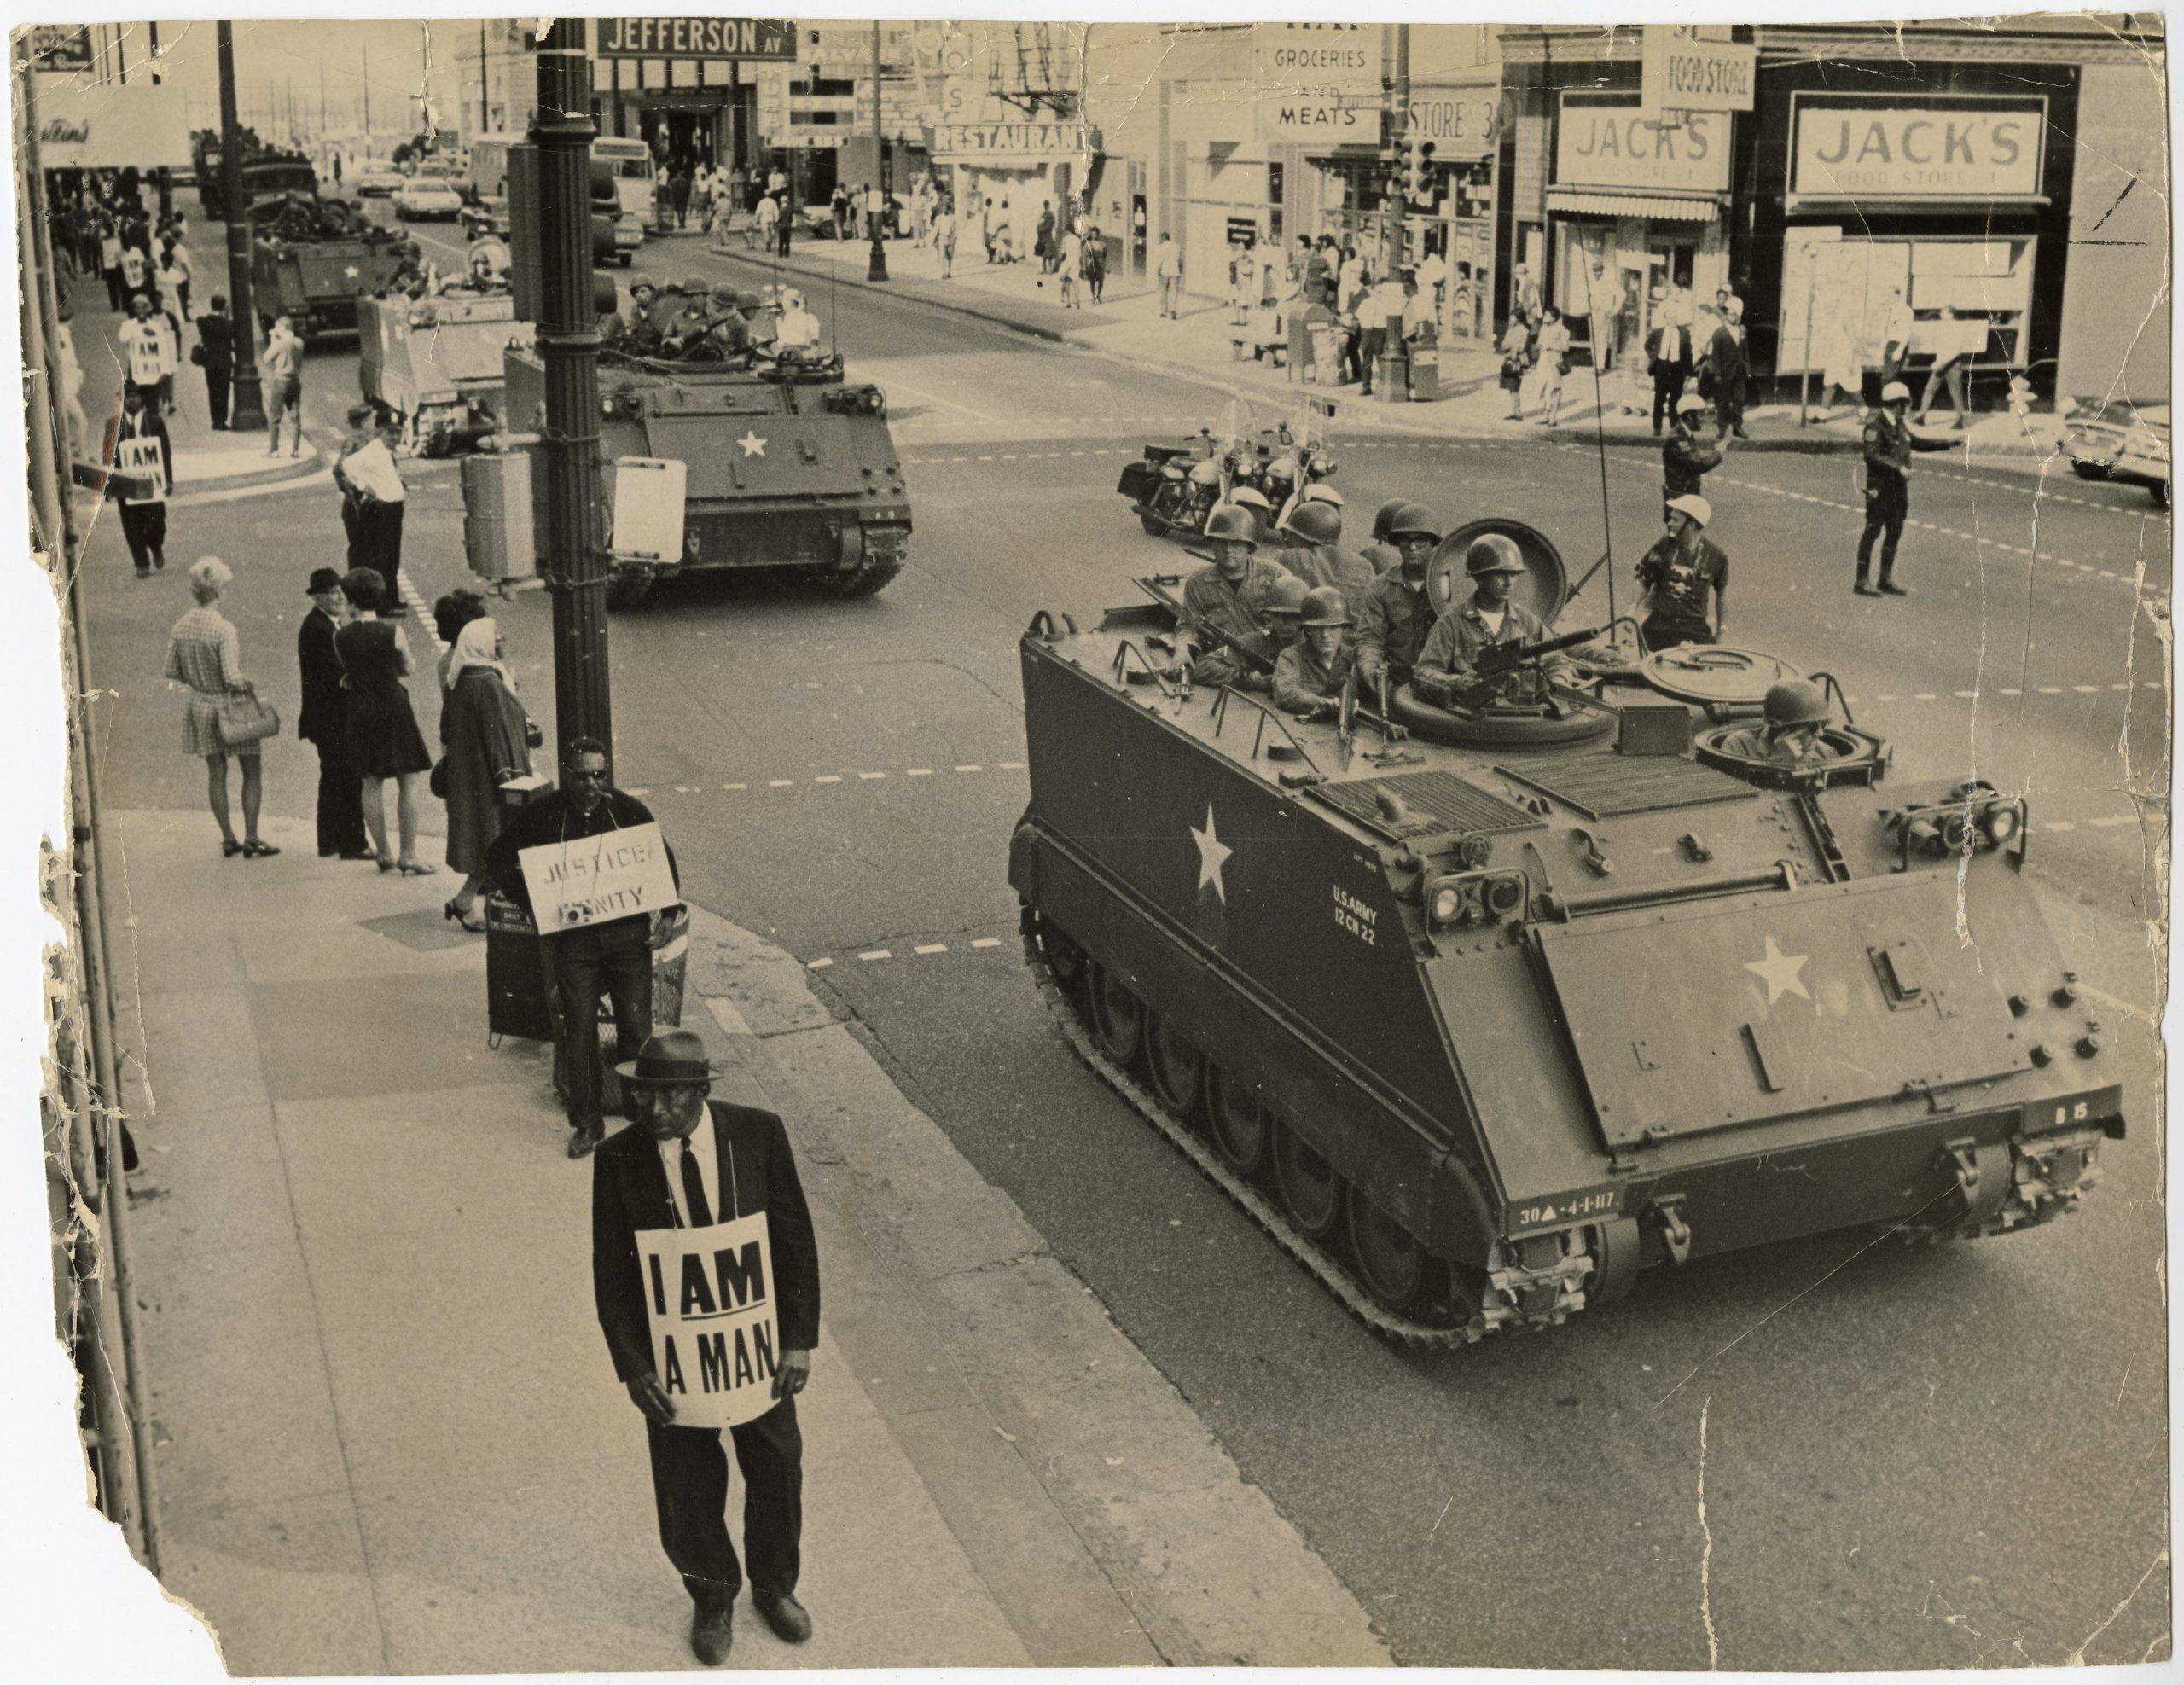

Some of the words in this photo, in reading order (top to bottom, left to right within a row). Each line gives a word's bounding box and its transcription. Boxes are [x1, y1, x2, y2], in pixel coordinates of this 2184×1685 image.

[607, 18, 757, 53] JEFFERSON
[764, 37, 781, 53] AV
[1275, 49, 1365, 67] GROCERIES
[1669, 55, 1704, 93] FOOD
[1706, 58, 1749, 95] STORE
[1298, 86, 1340, 99] AND
[1278, 107, 1356, 125] MEATS
[1409, 102, 1466, 138] STORE
[1482, 102, 1494, 139] 3
[1577, 117, 1709, 161] JACKS
[1815, 117, 2022, 165] JACK'S
[1834, 171, 1889, 185] FOOD
[1902, 171, 1964, 185] STORE
[139, 341, 160, 357] AM
[133, 445, 159, 468] AM
[544, 843, 646, 885] JUSTICE
[558, 886, 643, 922] NITY
[1362, 925, 1375, 946] 22
[1520, 1208, 1540, 1224] 30
[648, 1253, 667, 1315] I
[680, 1240, 766, 1315] AM
[665, 1334, 687, 1395] A
[696, 1319, 776, 1394] MAN
